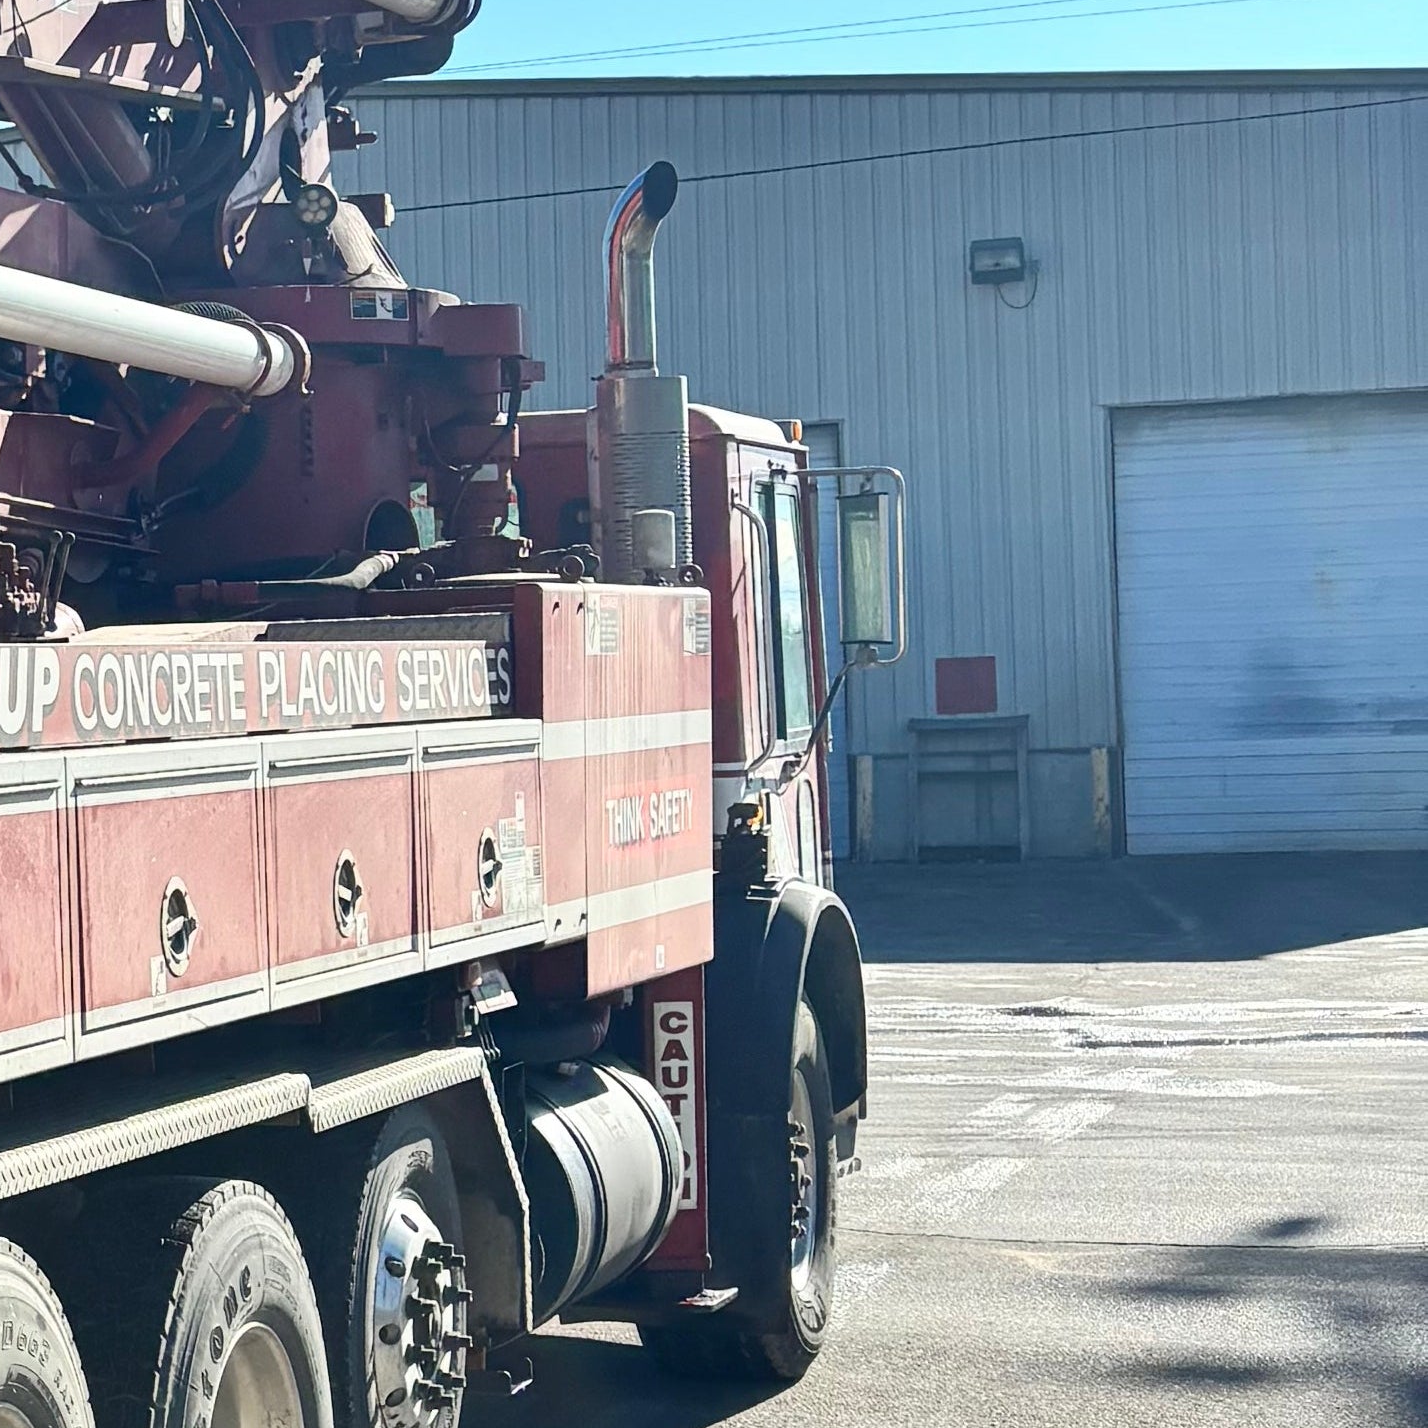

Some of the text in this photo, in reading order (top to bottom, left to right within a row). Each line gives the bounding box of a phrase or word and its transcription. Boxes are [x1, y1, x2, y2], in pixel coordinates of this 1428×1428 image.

[74, 651, 247, 731] CONCRETE
[259, 648, 385, 717] PLACING
[397, 645, 511, 709] SERVICES
[605, 788, 694, 846] THINK SAFETY
